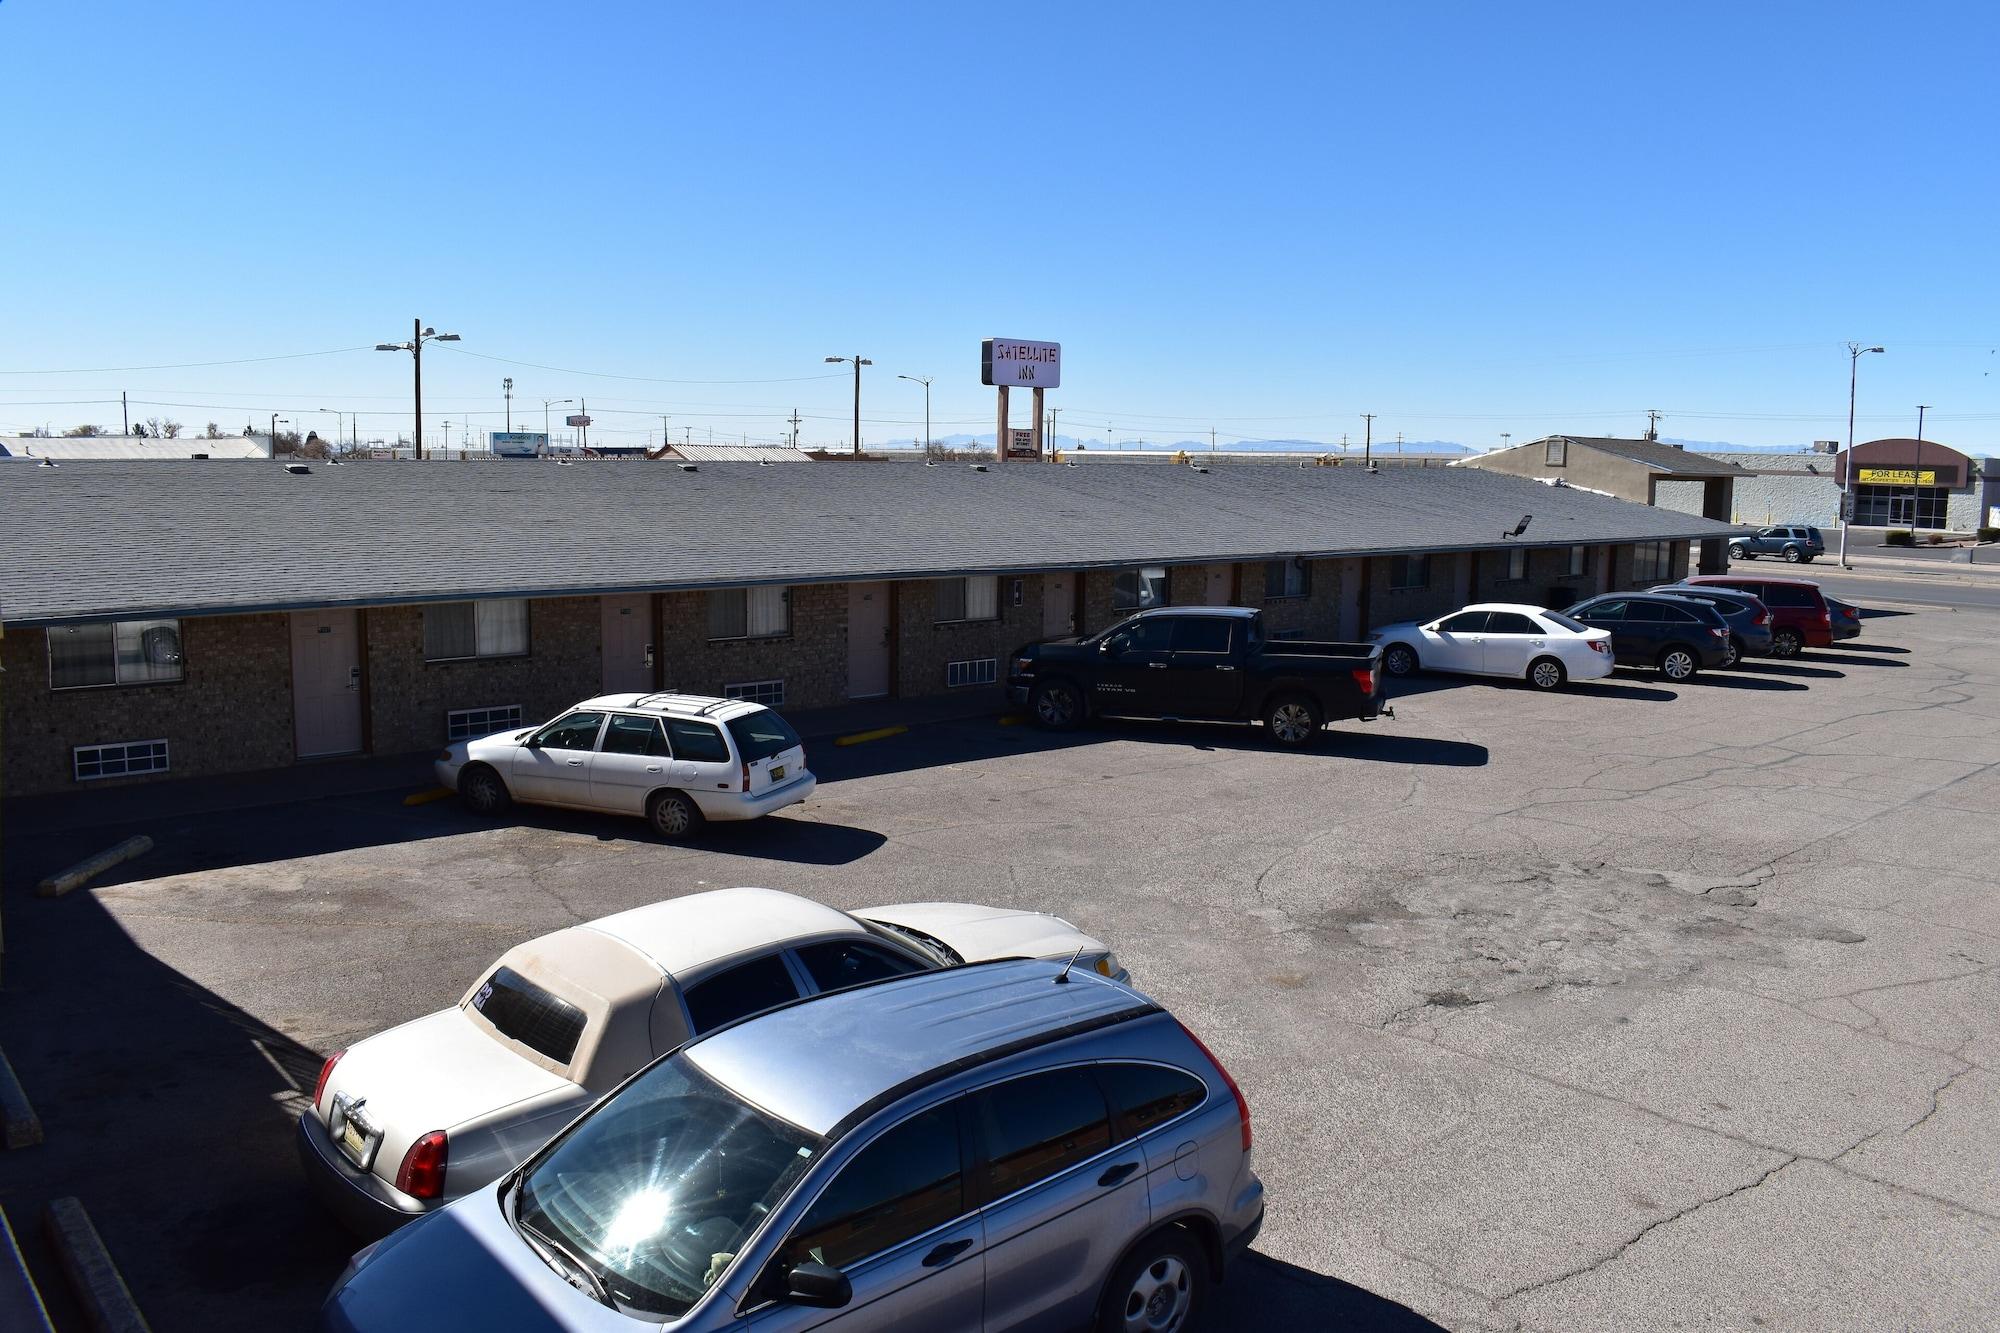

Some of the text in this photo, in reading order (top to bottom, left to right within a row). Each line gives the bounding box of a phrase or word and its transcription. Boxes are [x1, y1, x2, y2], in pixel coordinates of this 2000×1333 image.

[998, 344, 1056, 363] SATELLITE
[1018, 365, 1035, 380] INN
[1871, 470, 1923, 479] FOR LEASE
